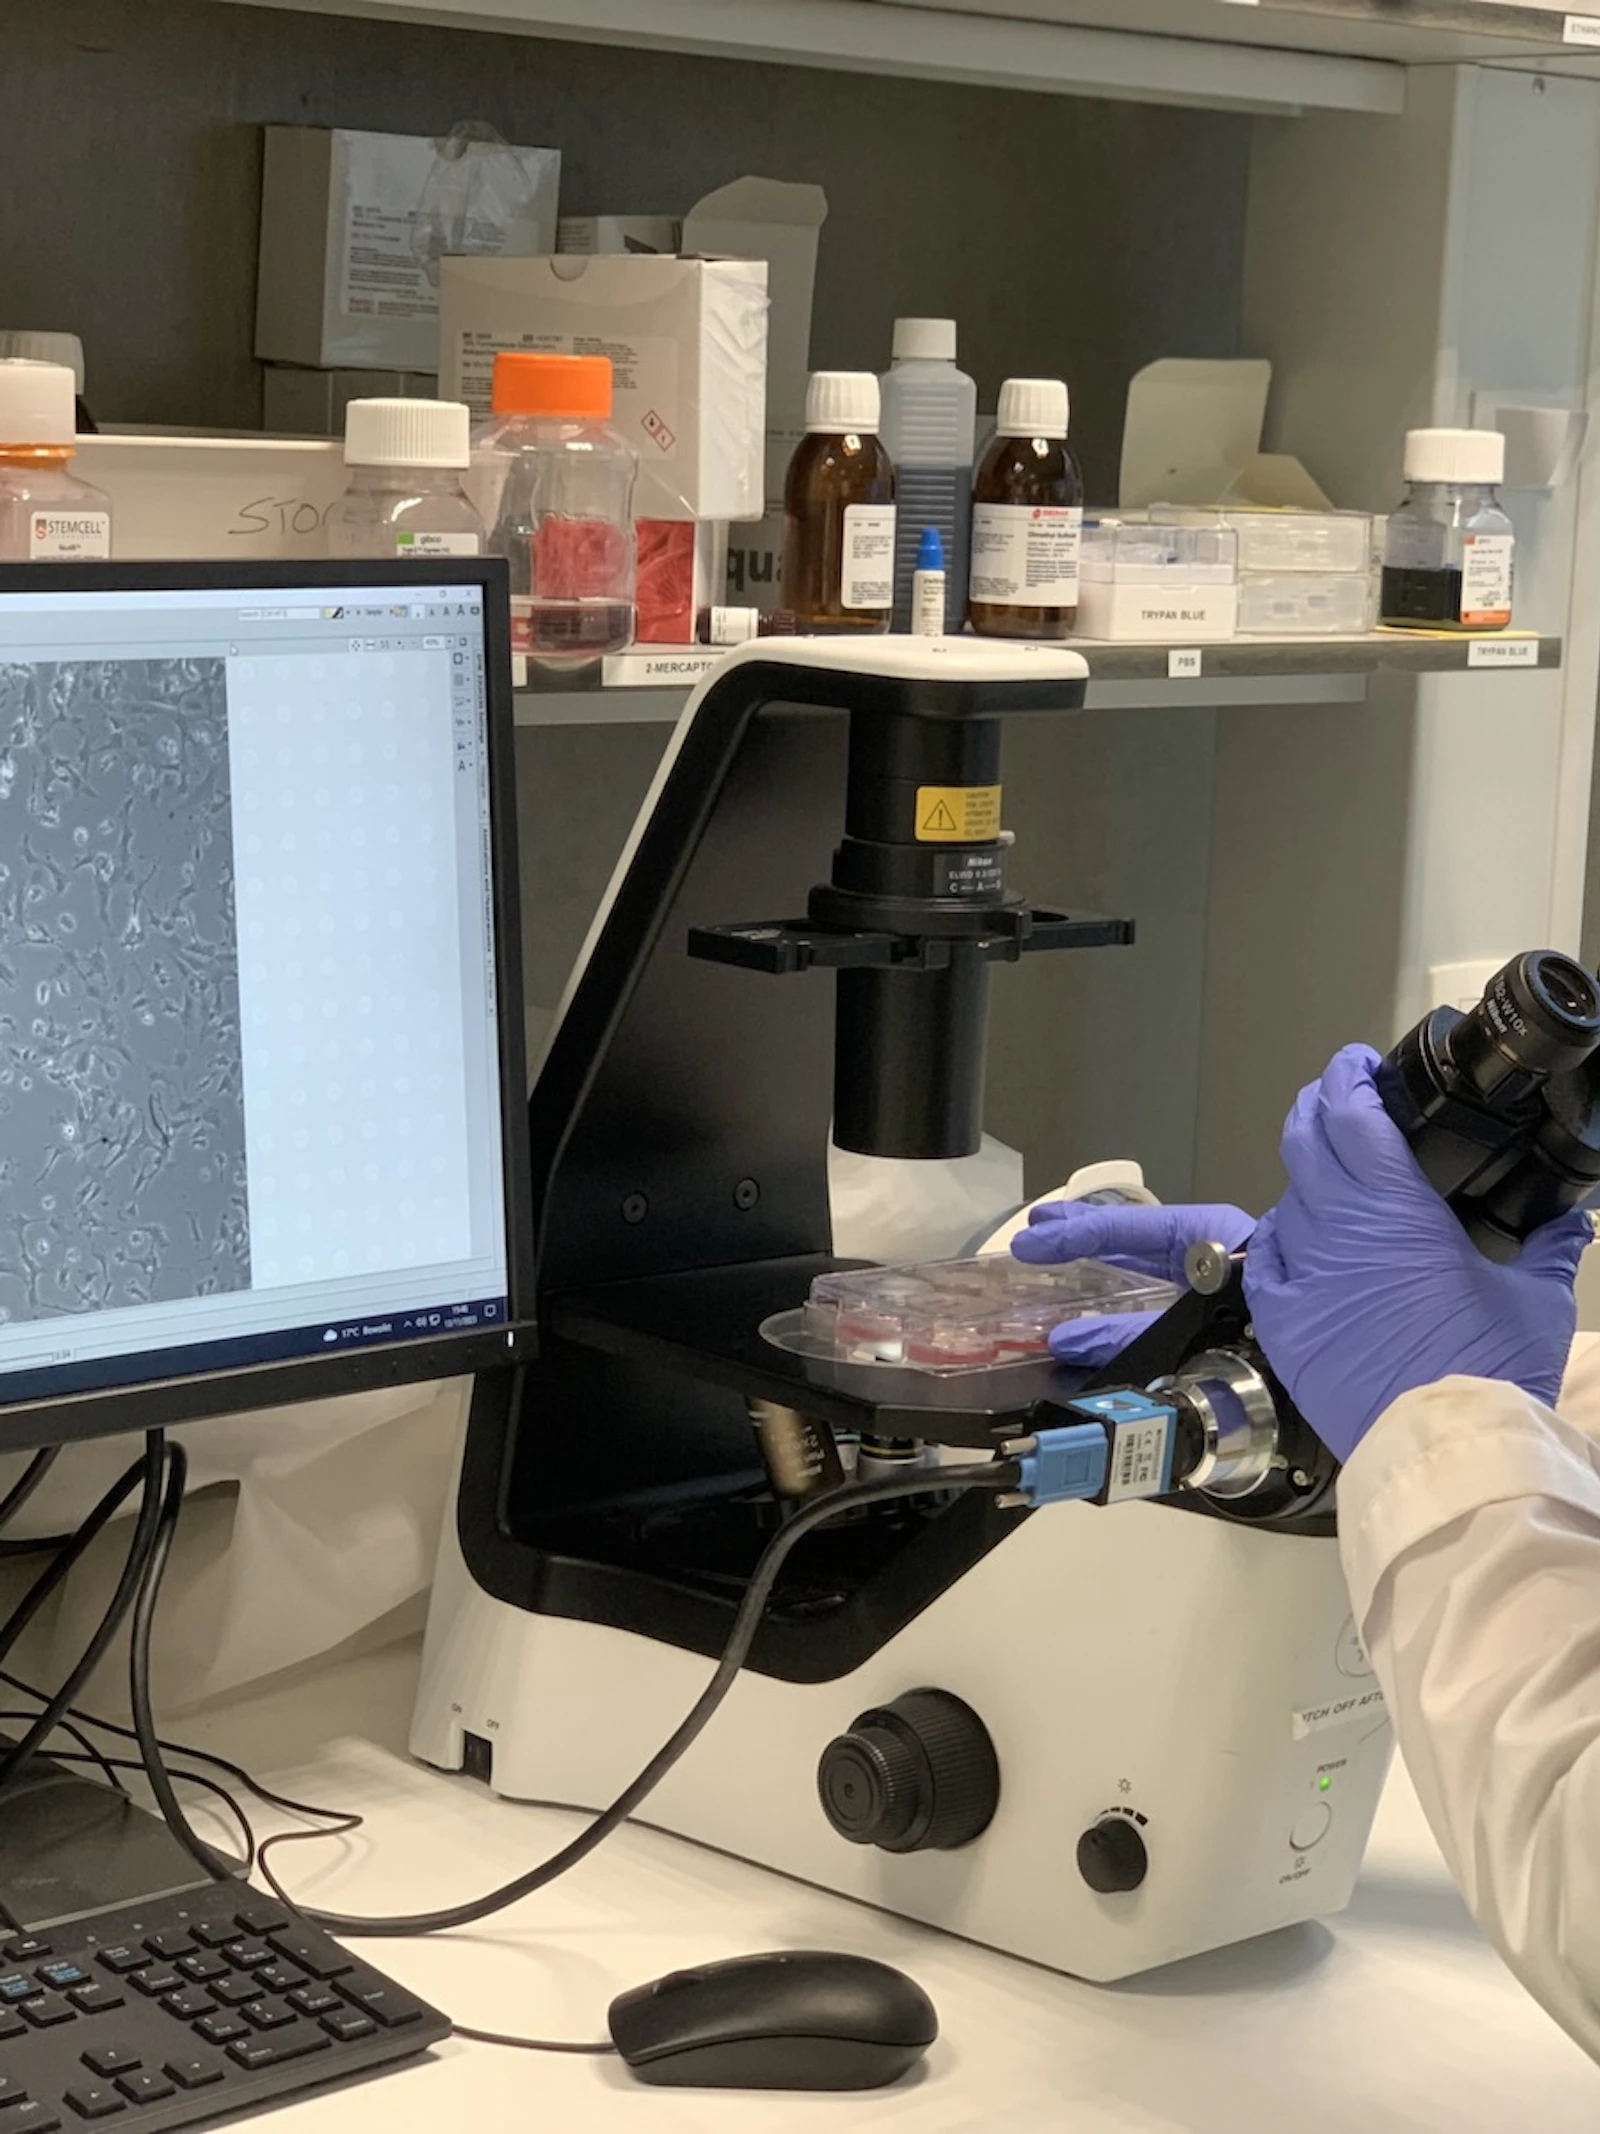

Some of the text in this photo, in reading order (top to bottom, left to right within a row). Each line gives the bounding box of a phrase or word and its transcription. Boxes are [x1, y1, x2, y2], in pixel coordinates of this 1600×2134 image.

[1141, 610, 1206, 621] TRYPAN BLUE
[1477, 646, 1528, 656] TRYPAN BLUE
[1178, 657, 1196, 668] PBS
[1486, 998, 1509, 1034] Nikon
[1333, 1697, 1358, 1715] OFF
[1316, 1758, 1348, 1774] POWER
[1278, 1867, 1312, 1885] ON/OFF
